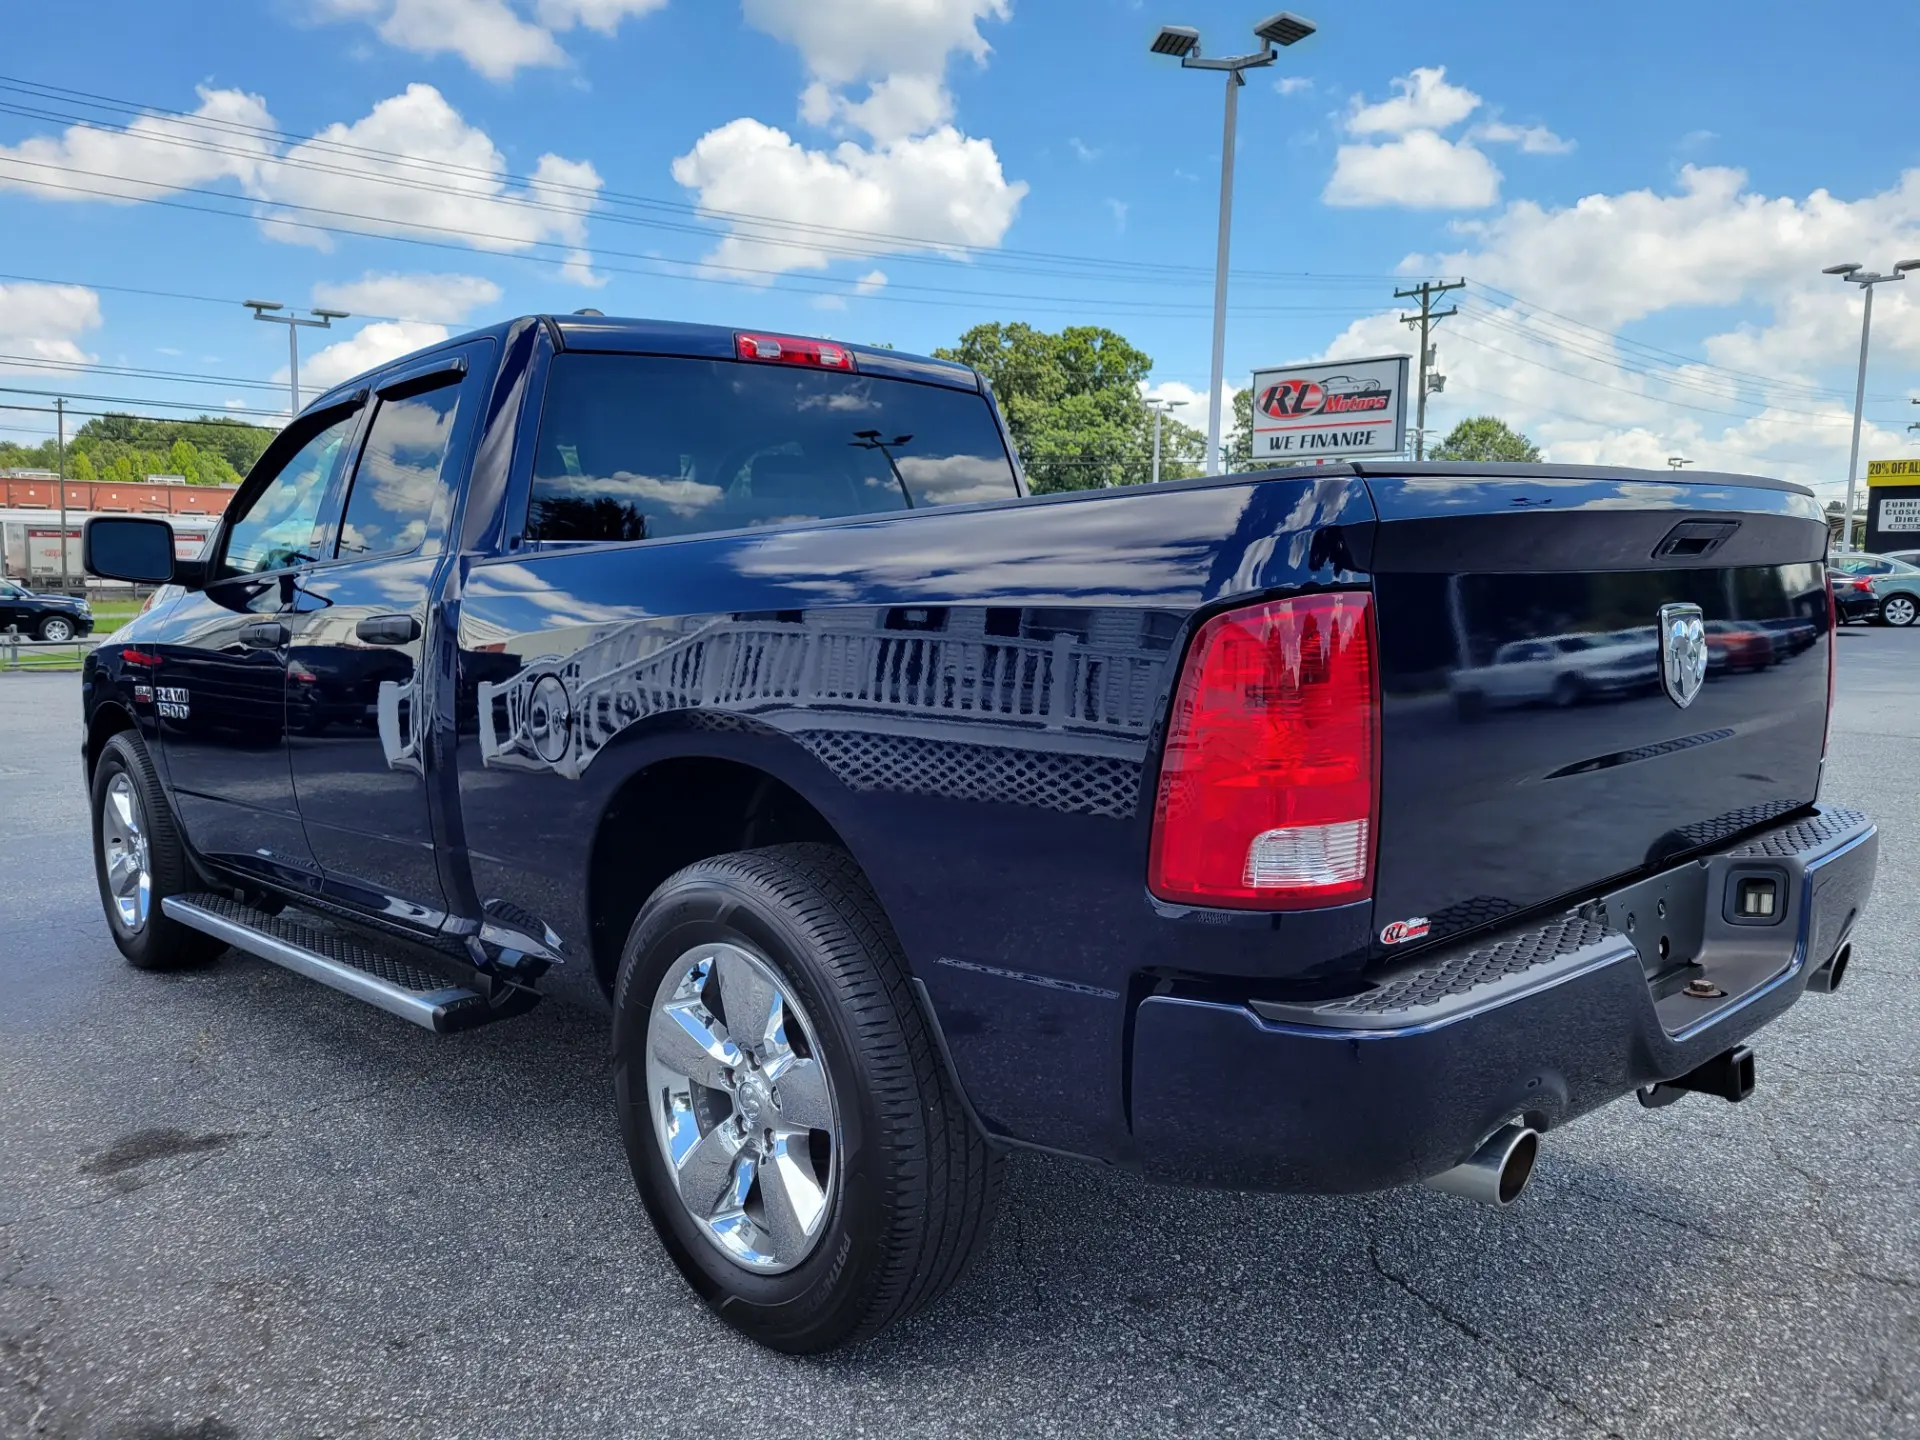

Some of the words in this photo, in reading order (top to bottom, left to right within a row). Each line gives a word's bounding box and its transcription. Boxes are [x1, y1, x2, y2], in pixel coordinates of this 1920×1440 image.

[1262, 384, 1314, 415] RL
[1324, 394, 1387, 413] Motors
[1270, 435, 1295, 450] WE
[1300, 430, 1377, 449] FINANCE
[1869, 463, 1889, 475] 20%
[1891, 462, 1907, 474] OFF
[156, 687, 188, 703] RAM
[157, 702, 190, 719] 1500
[1383, 924, 1406, 941] RL
